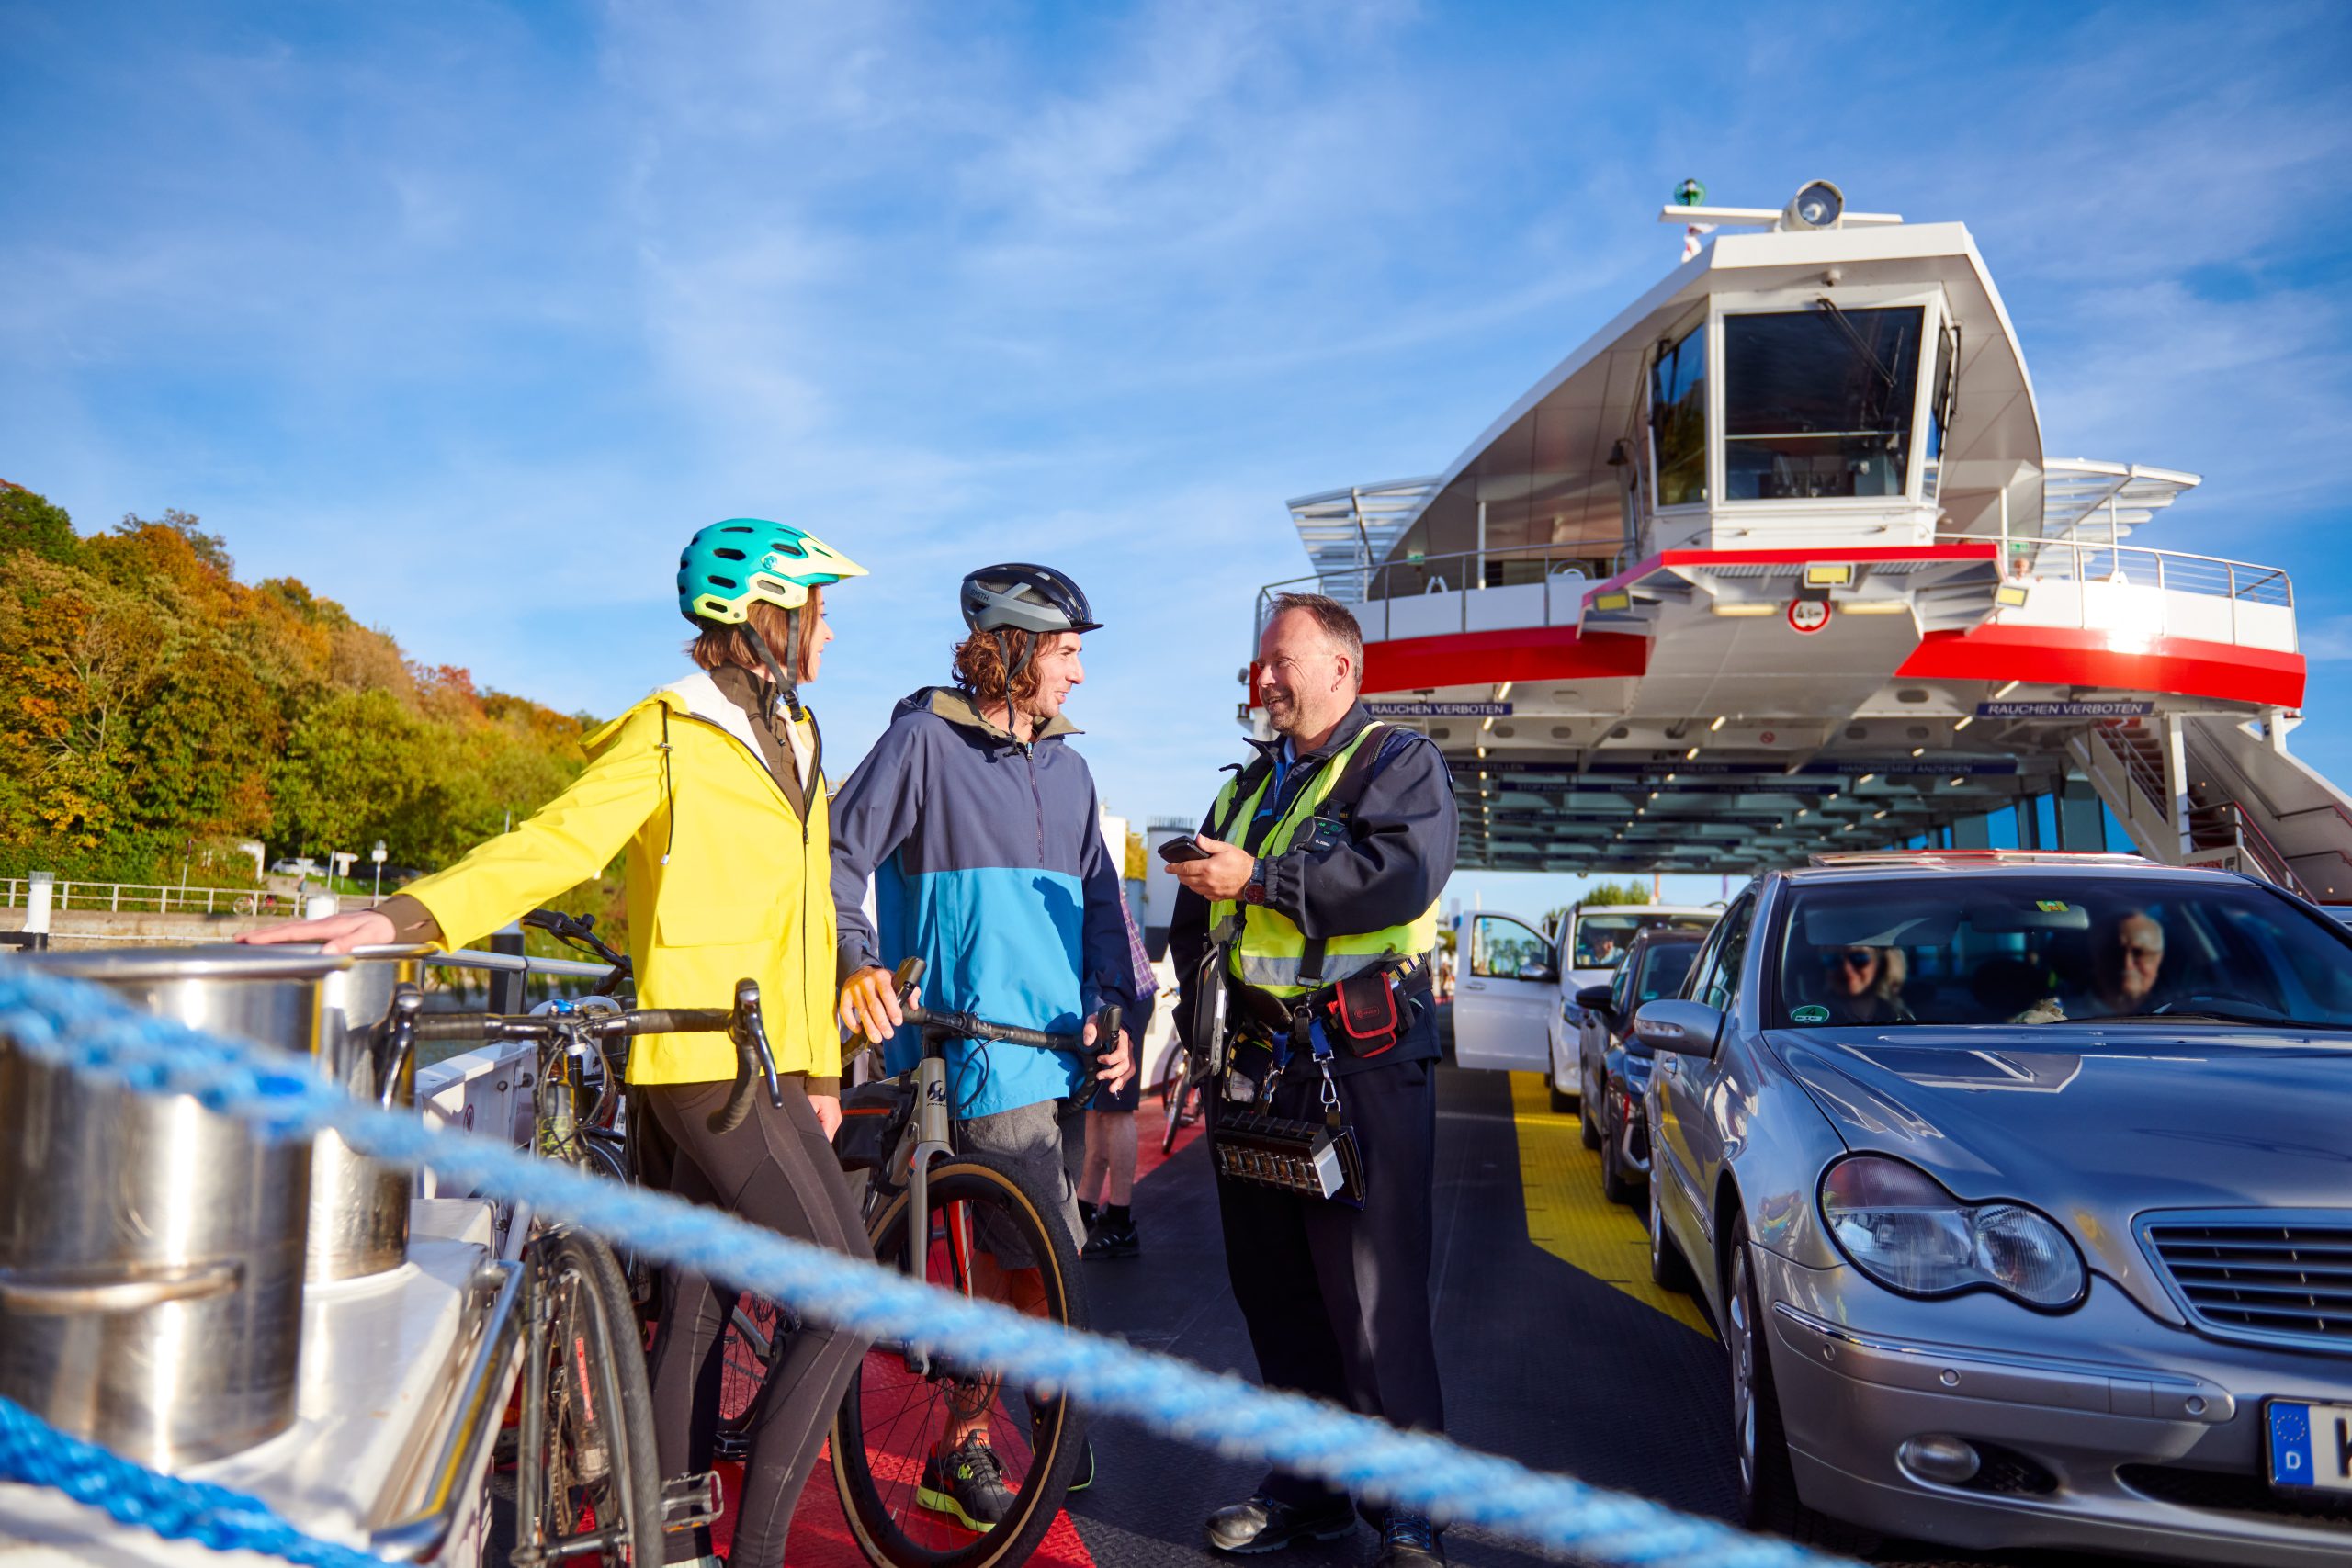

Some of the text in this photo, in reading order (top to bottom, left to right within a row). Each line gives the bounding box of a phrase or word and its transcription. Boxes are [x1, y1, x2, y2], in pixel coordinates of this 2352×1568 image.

[1371, 704, 1504, 715] RAUCHEN VERBOTEN
[1987, 703, 2143, 715] RAUCHEN VERBOTEN
[2285, 1450, 2301, 1470] D
